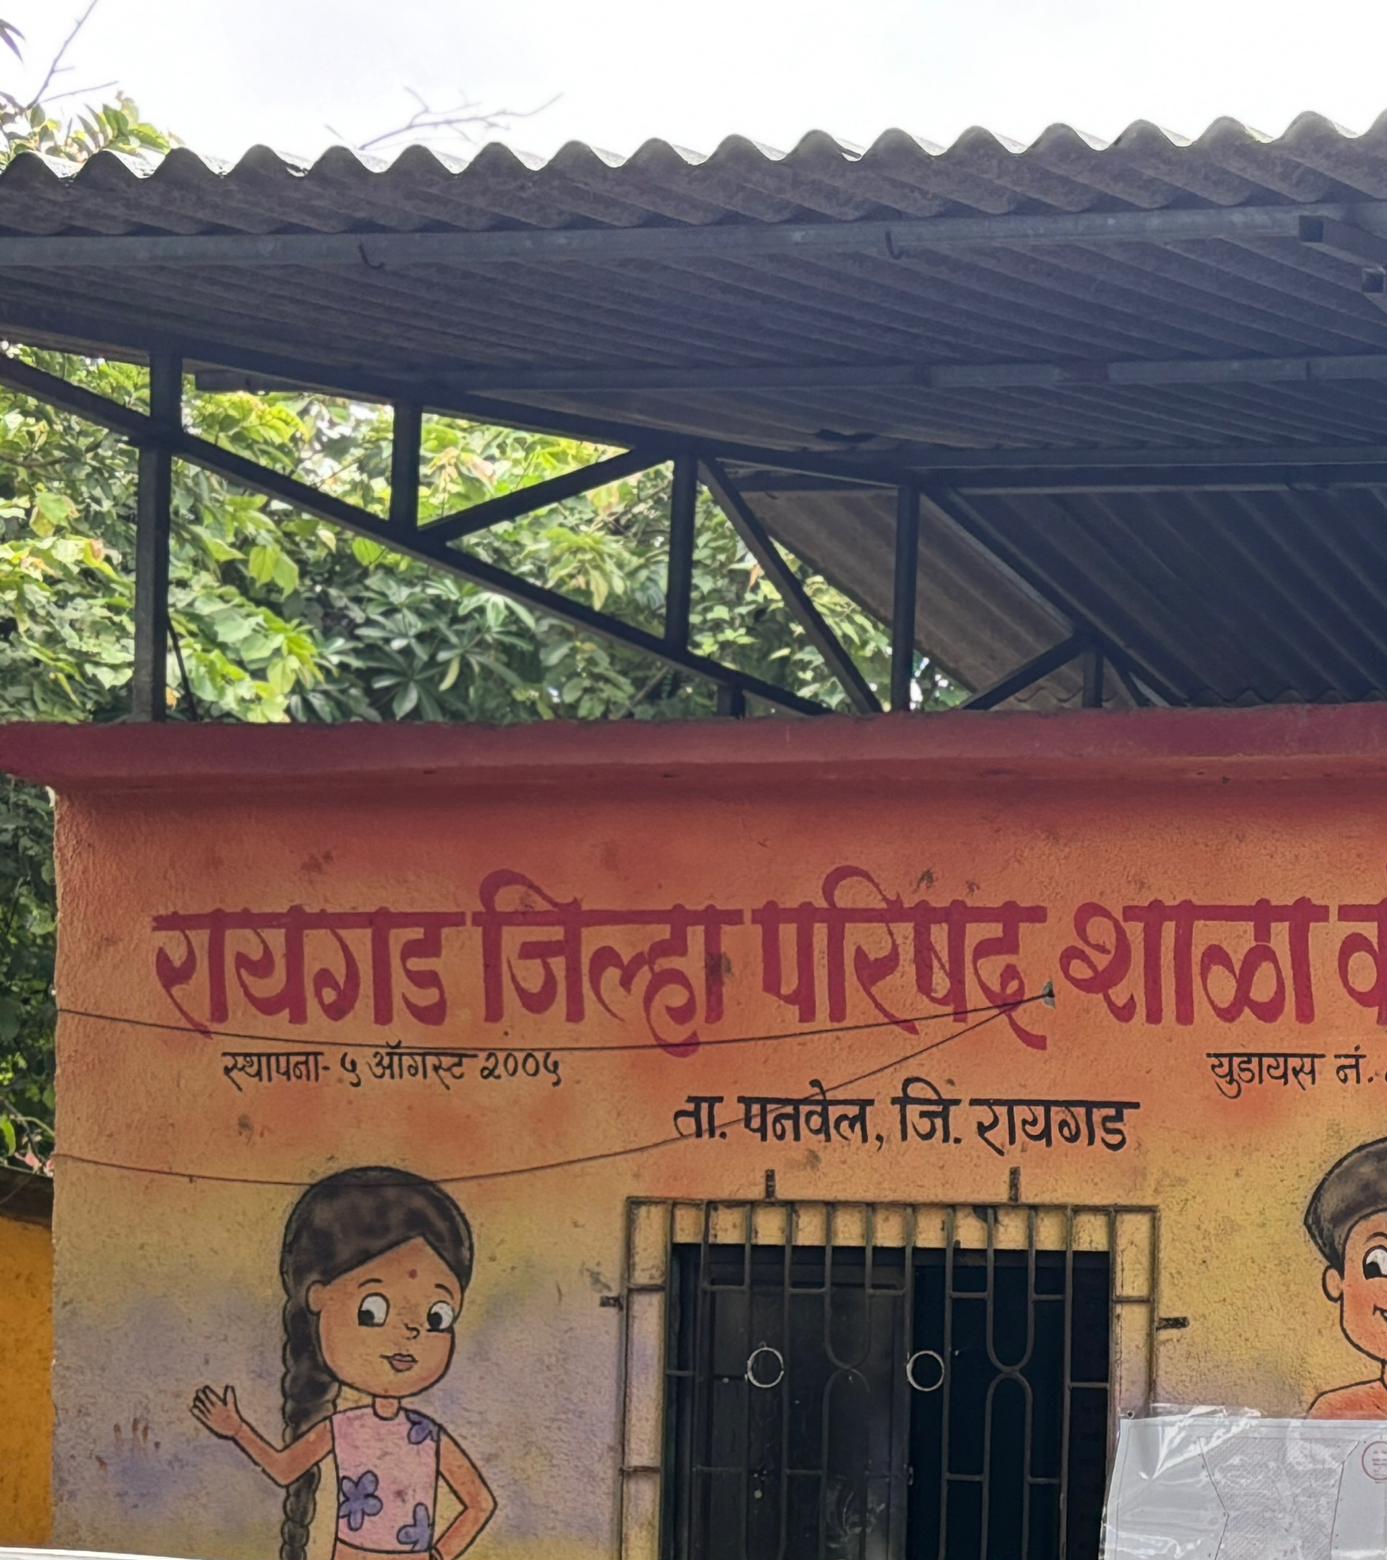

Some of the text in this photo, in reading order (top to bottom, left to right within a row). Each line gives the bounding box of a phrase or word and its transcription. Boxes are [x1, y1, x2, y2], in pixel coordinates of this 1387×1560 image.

[152, 904, 466, 1039] रायगड
[471, 868, 744, 1057] जिल्हा
[753, 865, 1047, 1049] परिषद
[1057, 899, 1330, 1026] शाळा
[340, 1053, 360, 1088] ५
[367, 1041, 480, 1086] ऑगस्ट
[481, 1051, 562, 1086] २००५
[1206, 1052, 1327, 1098] युडायस
[673, 1076, 1140, 1156] ता. पनवेल, जि. रायगड
